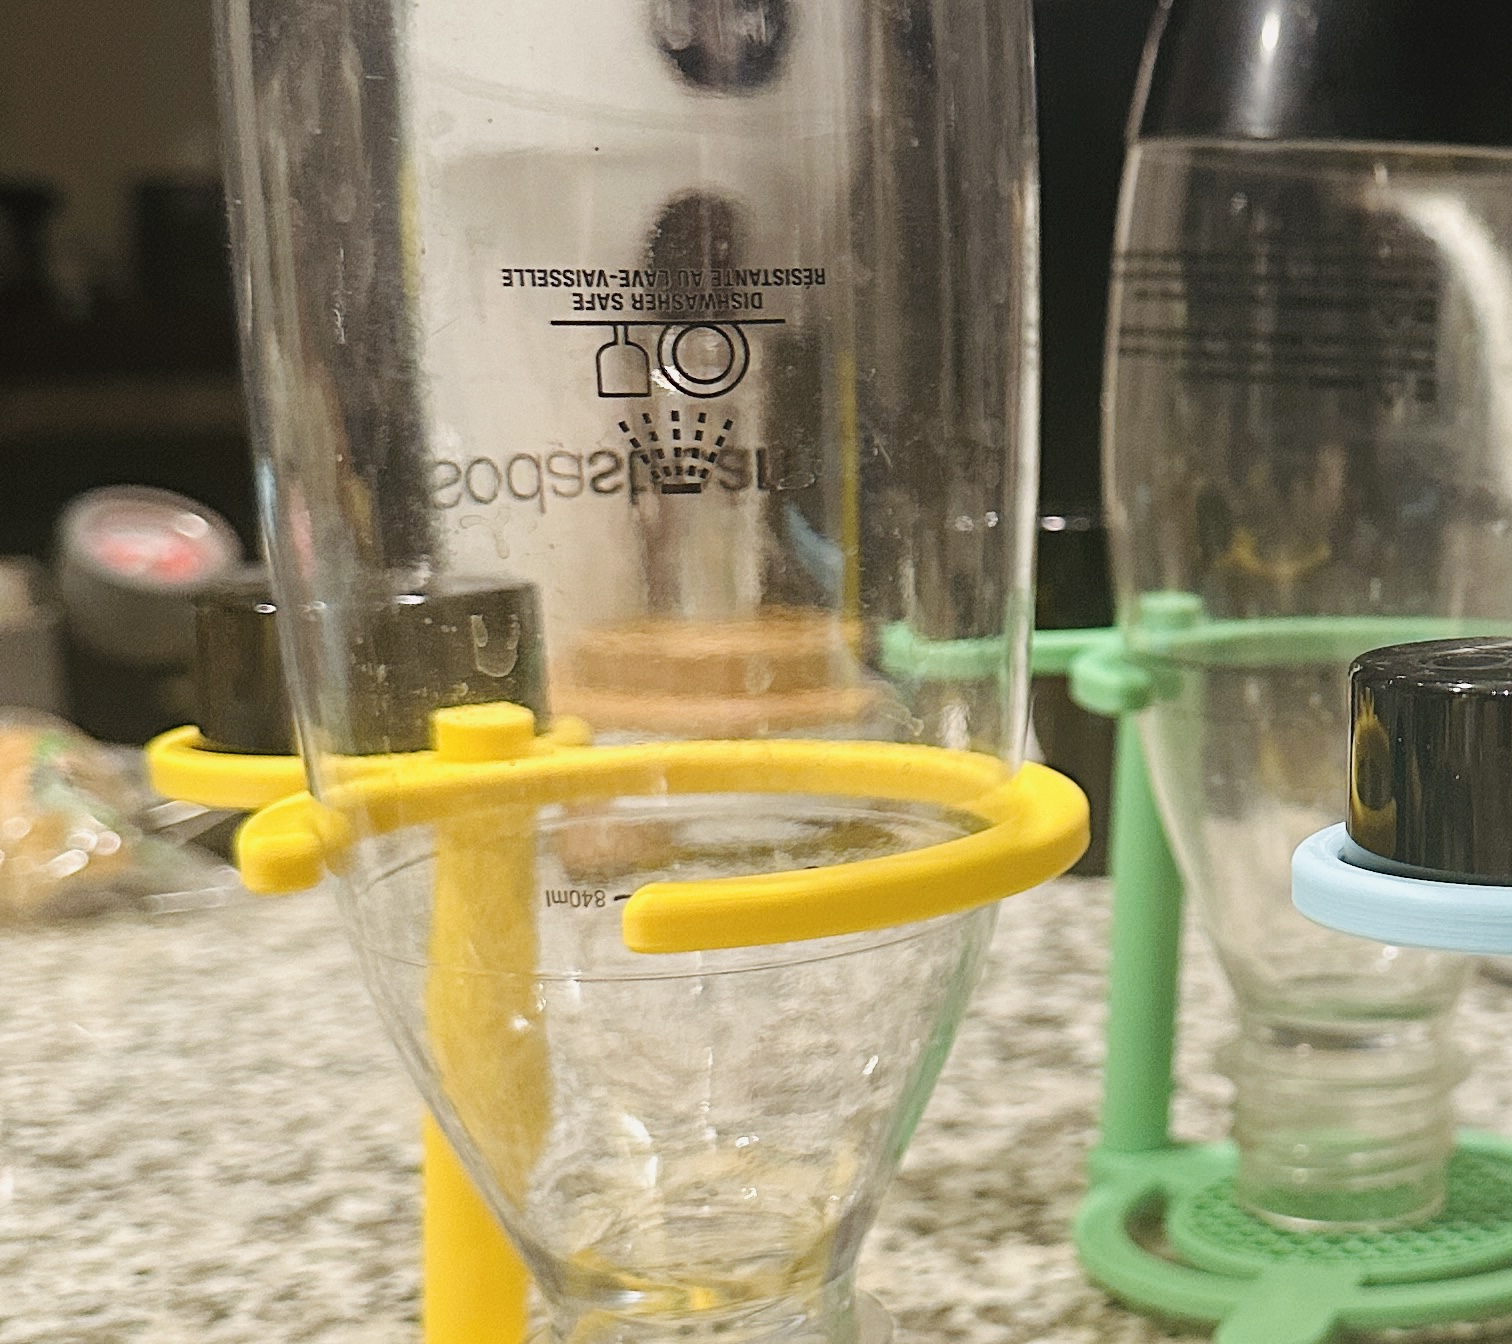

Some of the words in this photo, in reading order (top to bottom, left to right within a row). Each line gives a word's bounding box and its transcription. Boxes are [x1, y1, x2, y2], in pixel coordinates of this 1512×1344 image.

[501, 267, 670, 288] LAVE-VAISSELLE
[676, 268, 702, 286] AU
[711, 268, 825, 289] RÉSISTANTE
[571, 292, 625, 311] SAFE
[631, 292, 763, 311] DISHWASHER
[545, 888, 607, 908] 840ml
